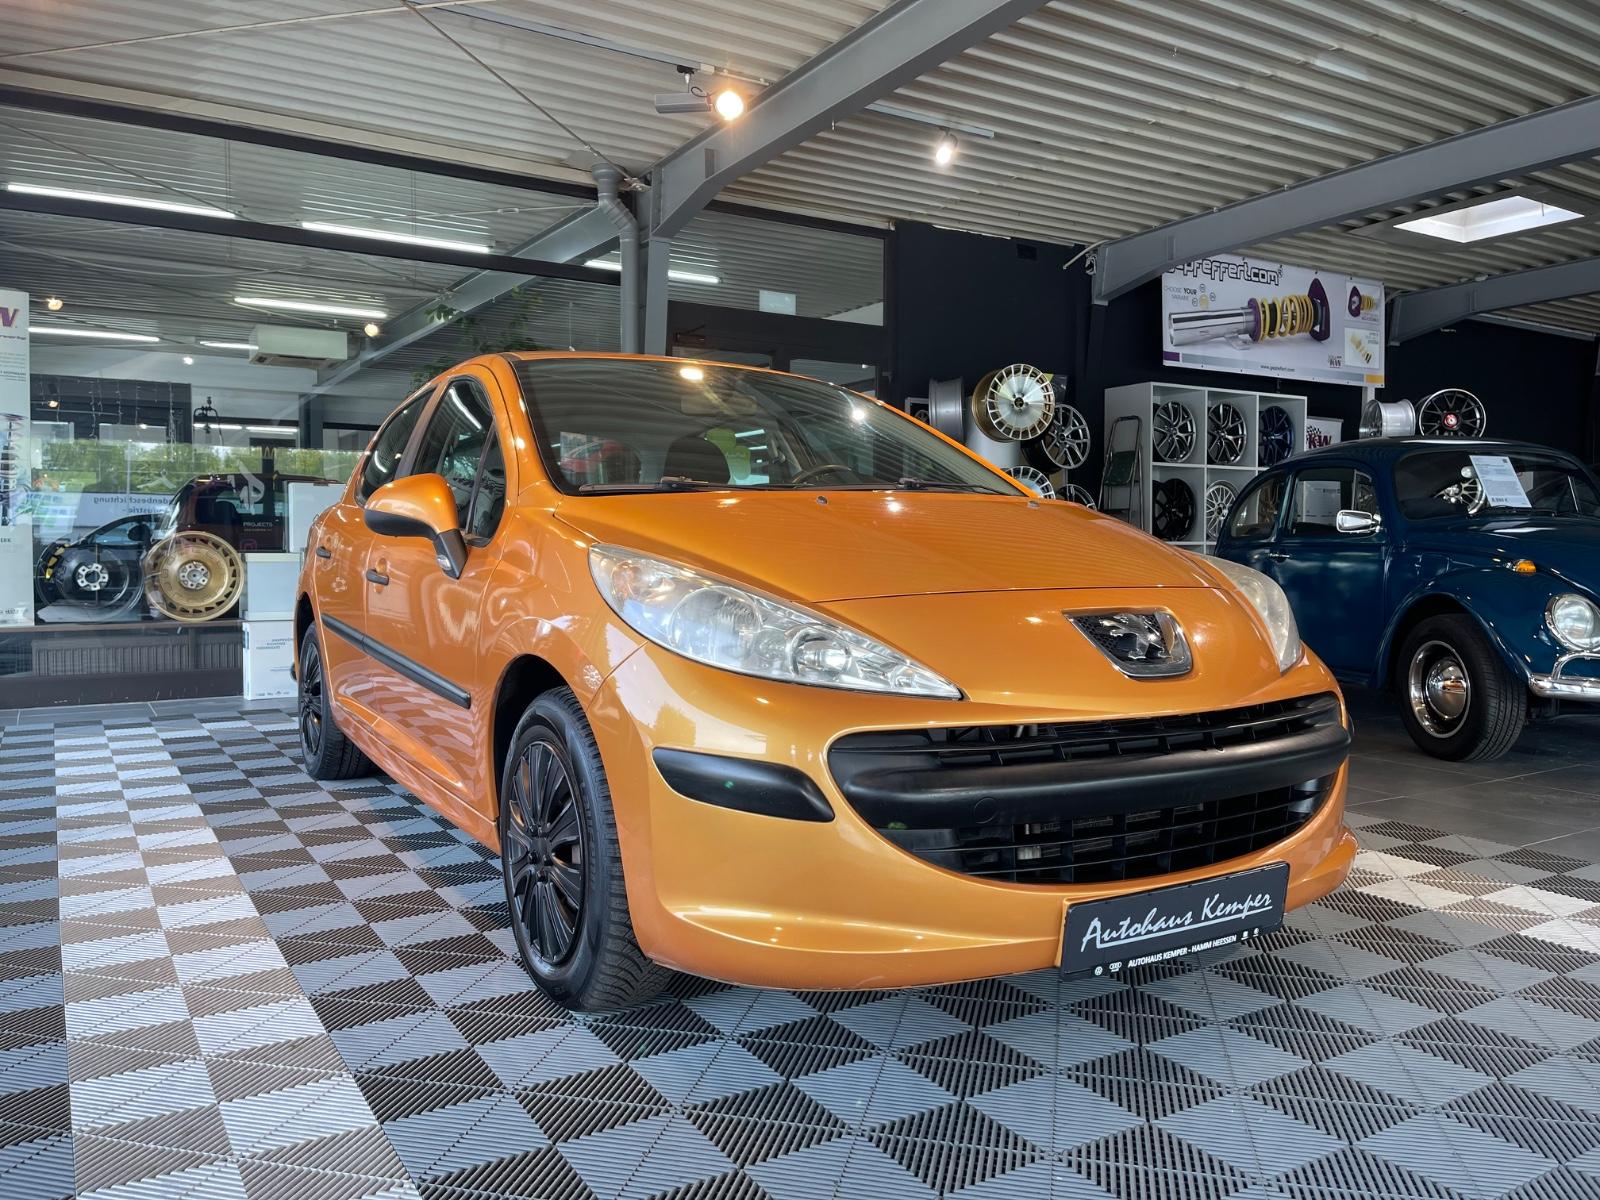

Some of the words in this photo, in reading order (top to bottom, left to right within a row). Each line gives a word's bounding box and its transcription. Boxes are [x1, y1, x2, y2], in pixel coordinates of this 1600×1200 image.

[1167, 258, 1280, 286] pfeffert.com
[1183, 287, 1198, 296] YOUR
[1080, 907, 1193, 953] Autohaus
[1201, 893, 1272, 920] Kemper
[1127, 953, 1163, 968] AUTOHAUS
[1163, 947, 1188, 960] KEMPER
[1191, 940, 1212, 953] HAMM
[1212, 935, 1237, 948] HEESSEN
